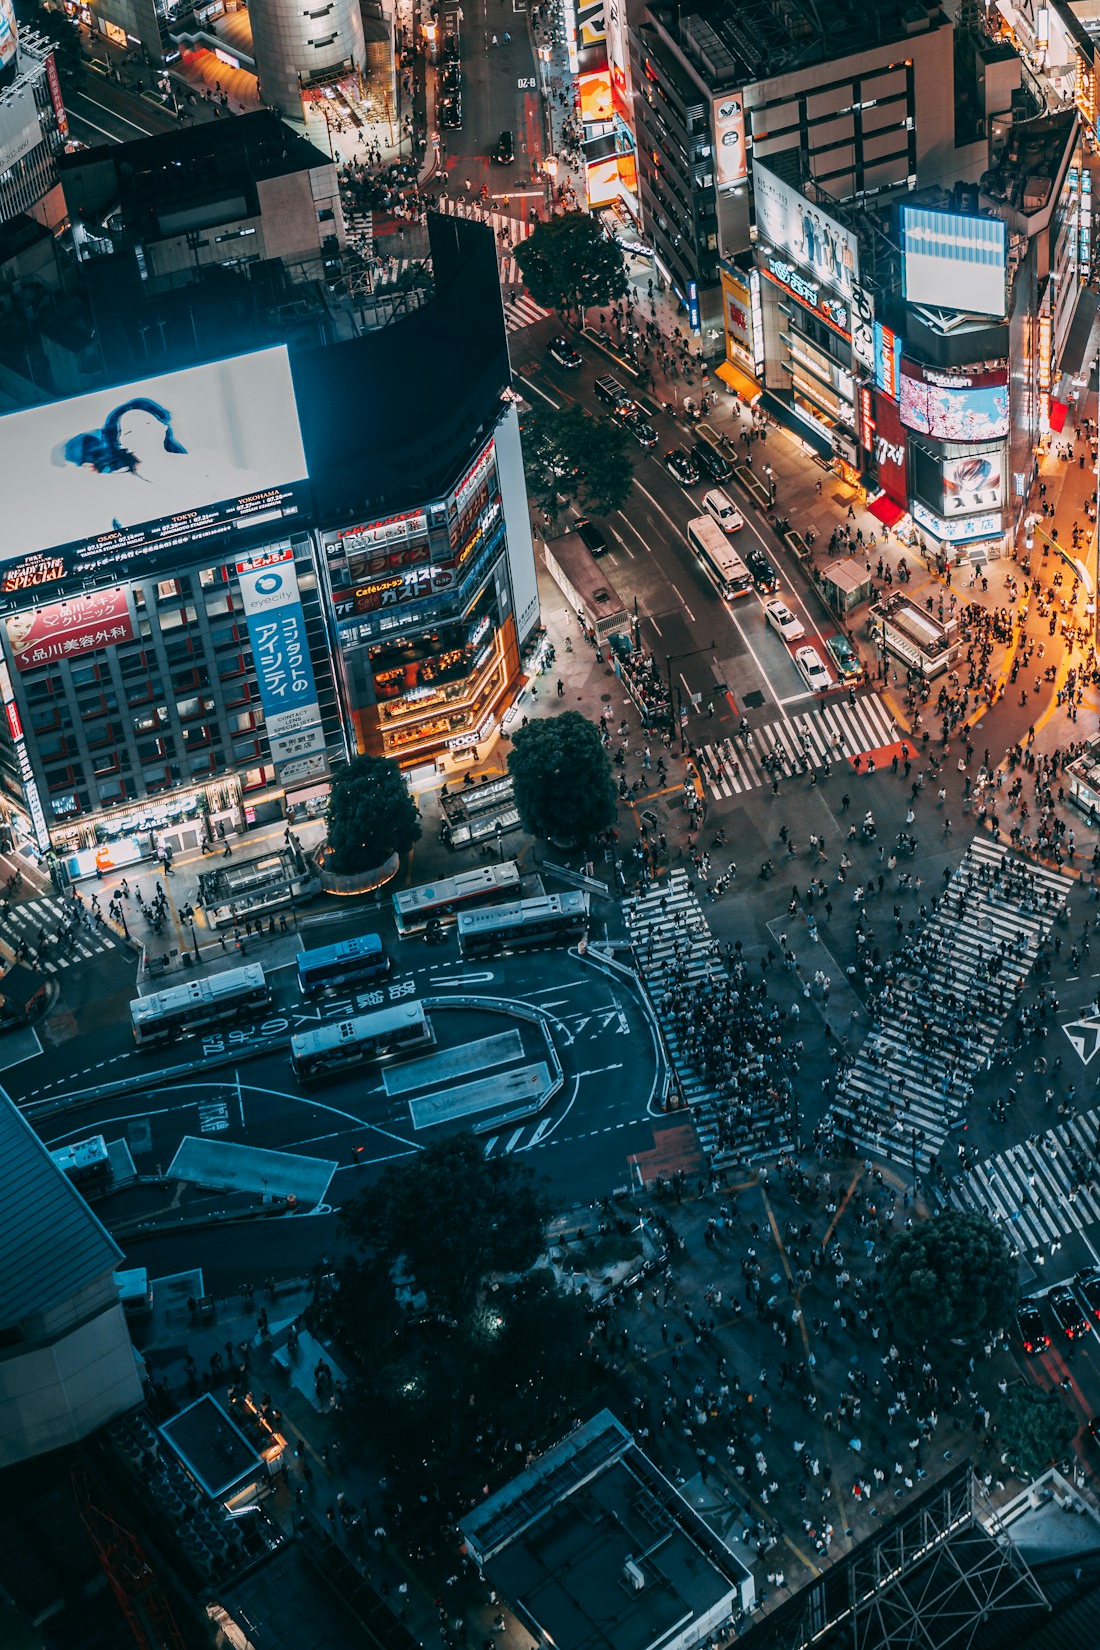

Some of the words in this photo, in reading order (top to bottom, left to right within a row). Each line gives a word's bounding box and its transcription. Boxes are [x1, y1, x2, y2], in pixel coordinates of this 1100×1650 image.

[517, 77, 536, 89] 8-20
[171, 511, 198, 523] TOKYO
[97, 532, 123, 543] OSAKA
[326, 542, 343, 555] 9F
[4, 566, 69, 593] SPECIAL
[404, 565, 443, 585] ガスト
[59, 593, 120, 618] 品川スキン
[250, 589, 293, 609] eyecity
[61, 605, 116, 628] クリニック
[335, 602, 354, 617] 7F
[32, 625, 128, 663] 品川美容外科
[255, 622, 287, 697] アイシティ
[281, 617, 308, 693] コンタクトの
[273, 717, 315, 733] SPECIALISTS
[278, 710, 308, 722] CONTACT
[285, 717, 302, 725] LENS
[103, 795, 198, 835] サンドラッグ
